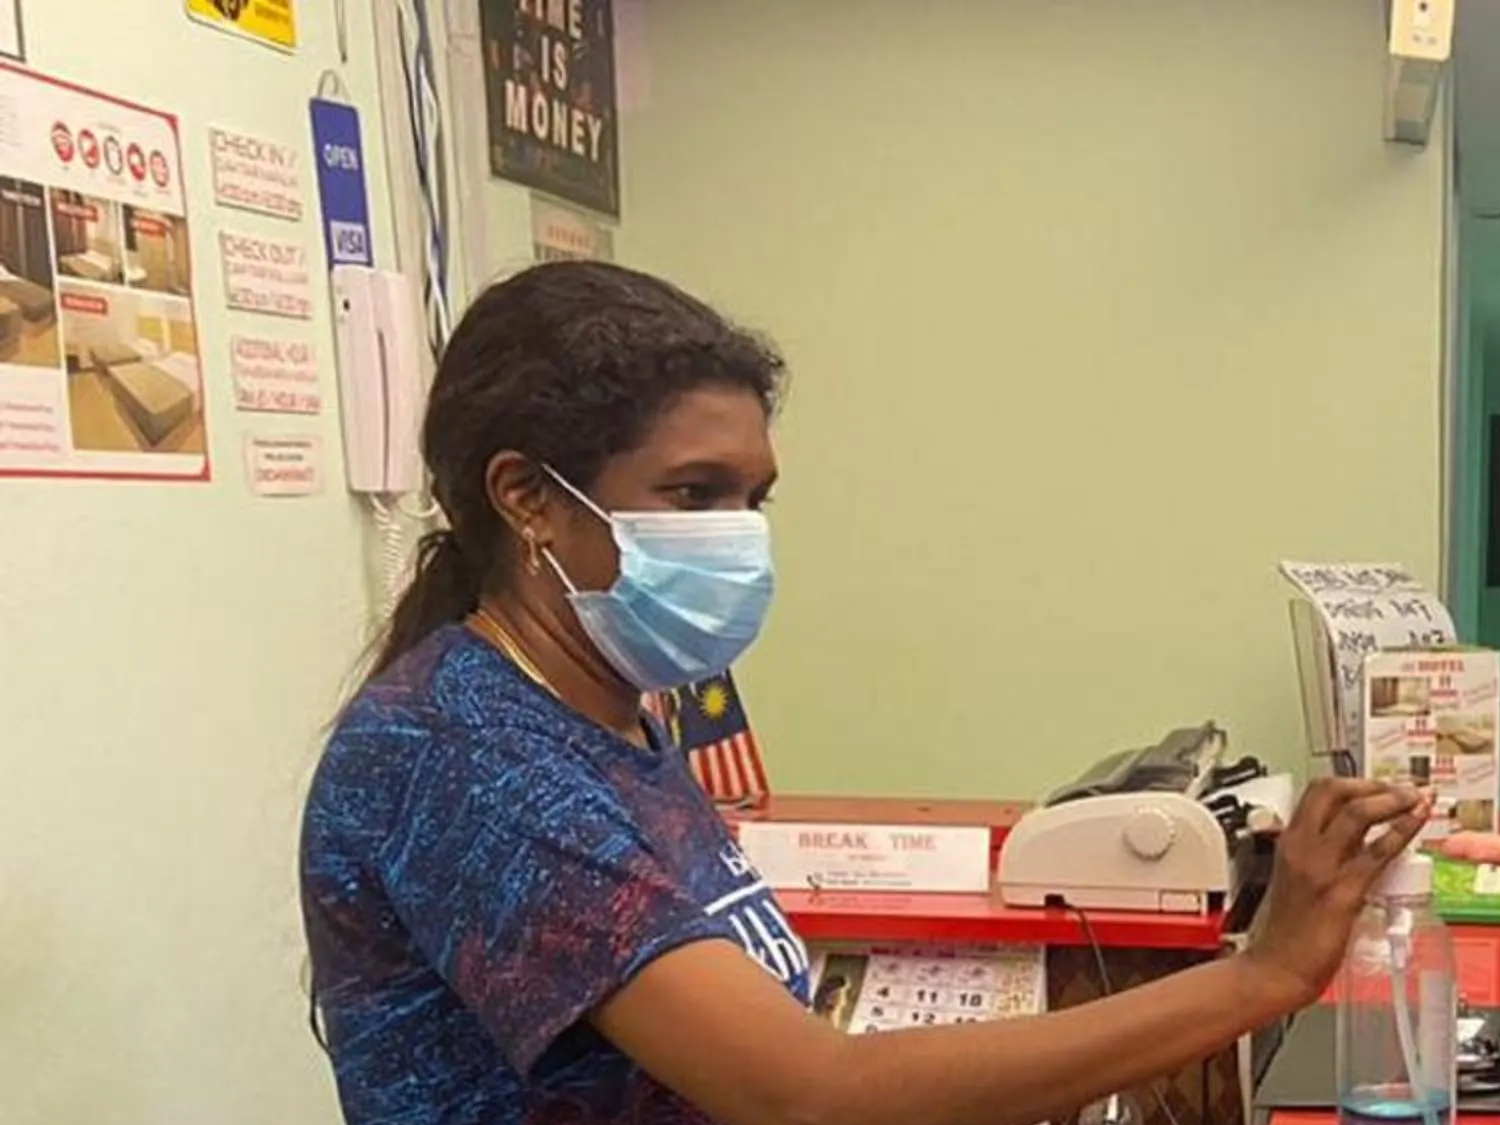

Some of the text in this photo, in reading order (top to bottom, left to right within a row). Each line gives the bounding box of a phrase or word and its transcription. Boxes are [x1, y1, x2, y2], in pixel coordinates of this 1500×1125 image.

[519, 0, 584, 40] ME
[540, 34, 570, 91] IS
[504, 78, 602, 163] MONEY
[322, 143, 359, 172] OPEN
[337, 228, 364, 254] VISA
[798, 832, 937, 851] BREAK TIME
